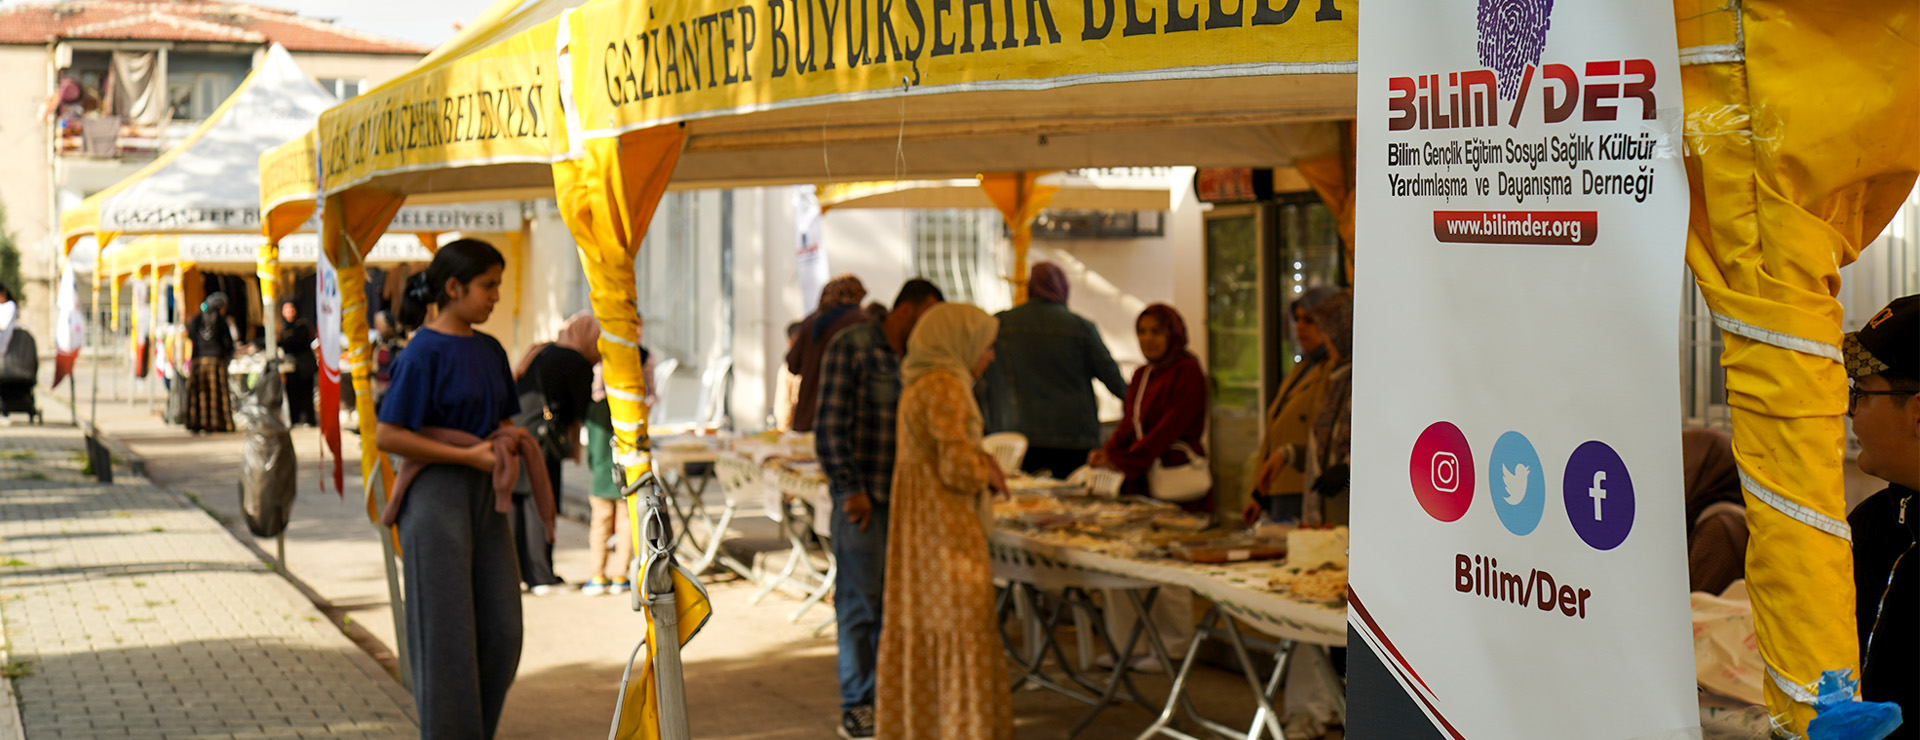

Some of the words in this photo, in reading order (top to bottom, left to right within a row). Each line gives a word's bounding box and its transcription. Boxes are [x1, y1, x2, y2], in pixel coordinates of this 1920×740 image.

[604, 5, 756, 108] GAZİANTEP
[1388, 142, 1420, 166] Bilim
[1423, 141, 1462, 172] Gençlik
[1465, 137, 1502, 171] Eğitim
[1505, 137, 1548, 170] Sosyal
[1551, 133, 1593, 169] Sağlık
[1598, 133, 1657, 161] Kültür
[1388, 173, 1468, 203] Yardımlaşma
[1475, 177, 1490, 196] ve
[1498, 171, 1572, 203] Dayanışma
[1582, 166, 1654, 203] Derneği
[1447, 213, 1582, 243] www.bilimder.org
[1455, 553, 1592, 619] Bilim/Der
